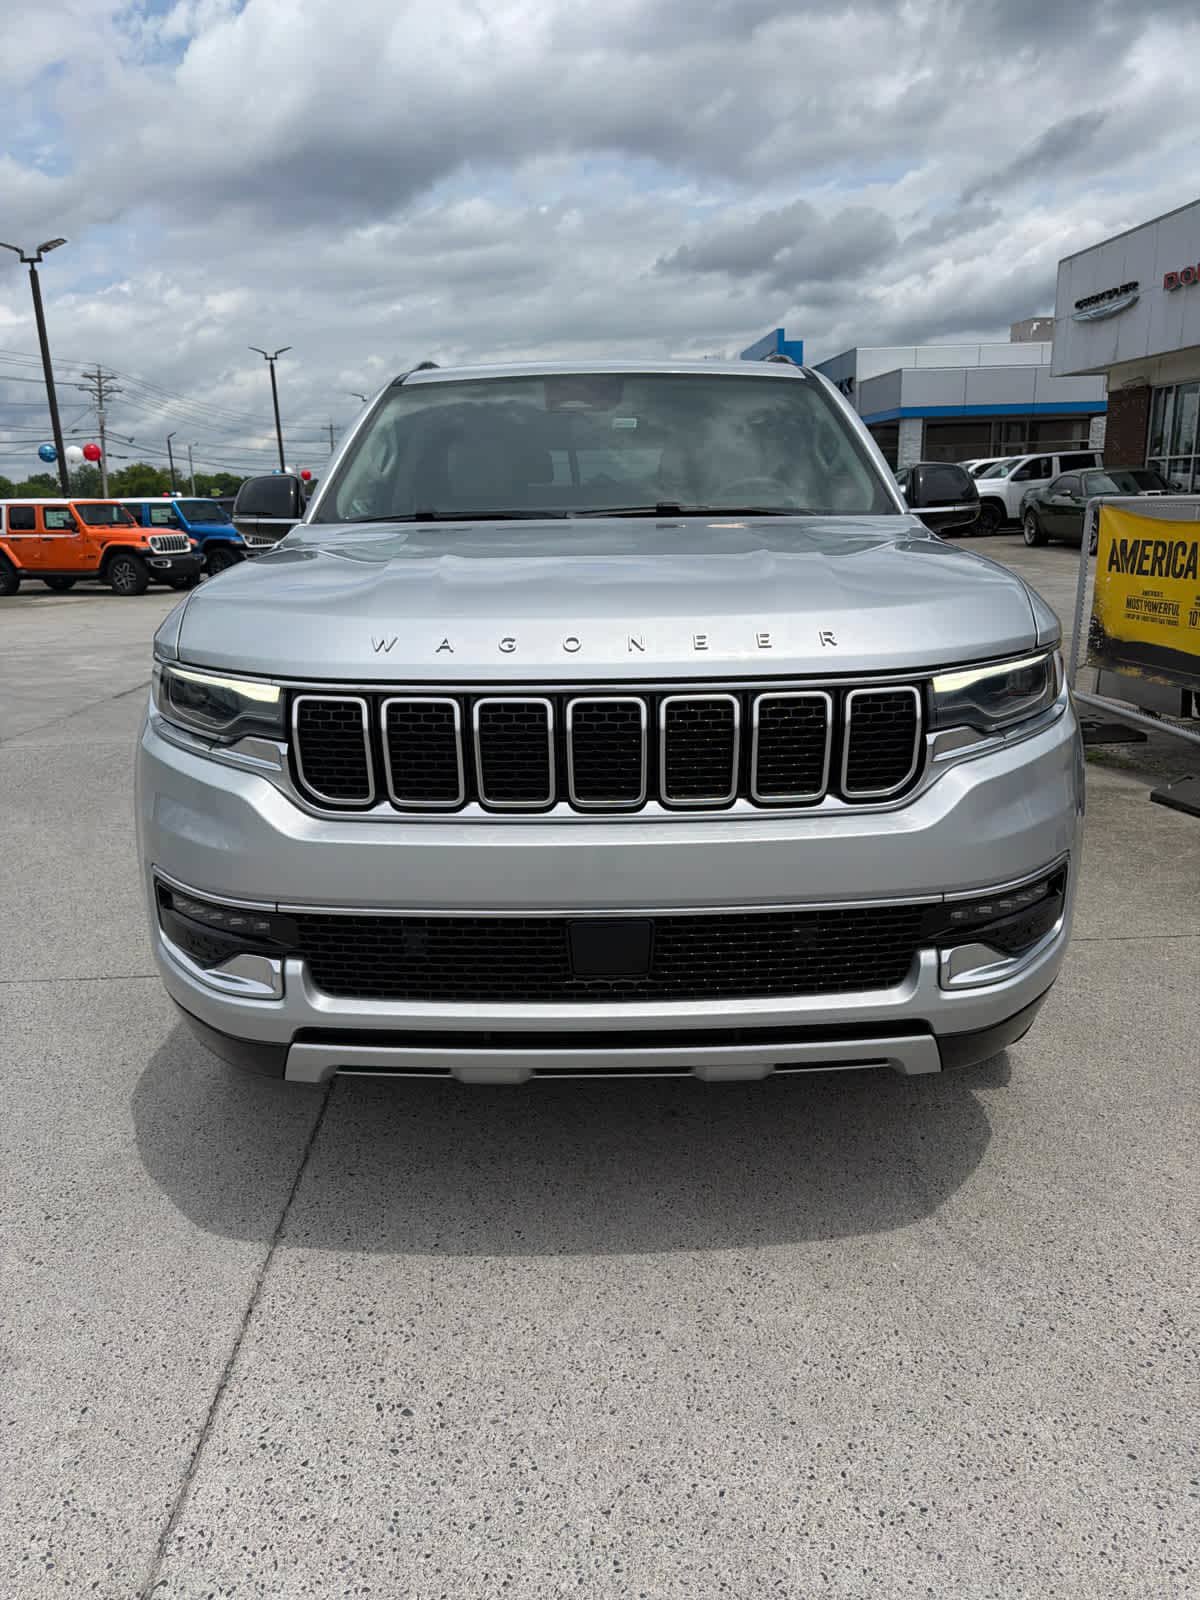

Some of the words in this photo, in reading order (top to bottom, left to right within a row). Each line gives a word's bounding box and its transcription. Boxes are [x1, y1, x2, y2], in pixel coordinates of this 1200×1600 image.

[1126, 597, 1144, 611] MOST
[1144, 599, 1180, 616] POWERFUL
[371, 631, 838, 653] WAGONEER
